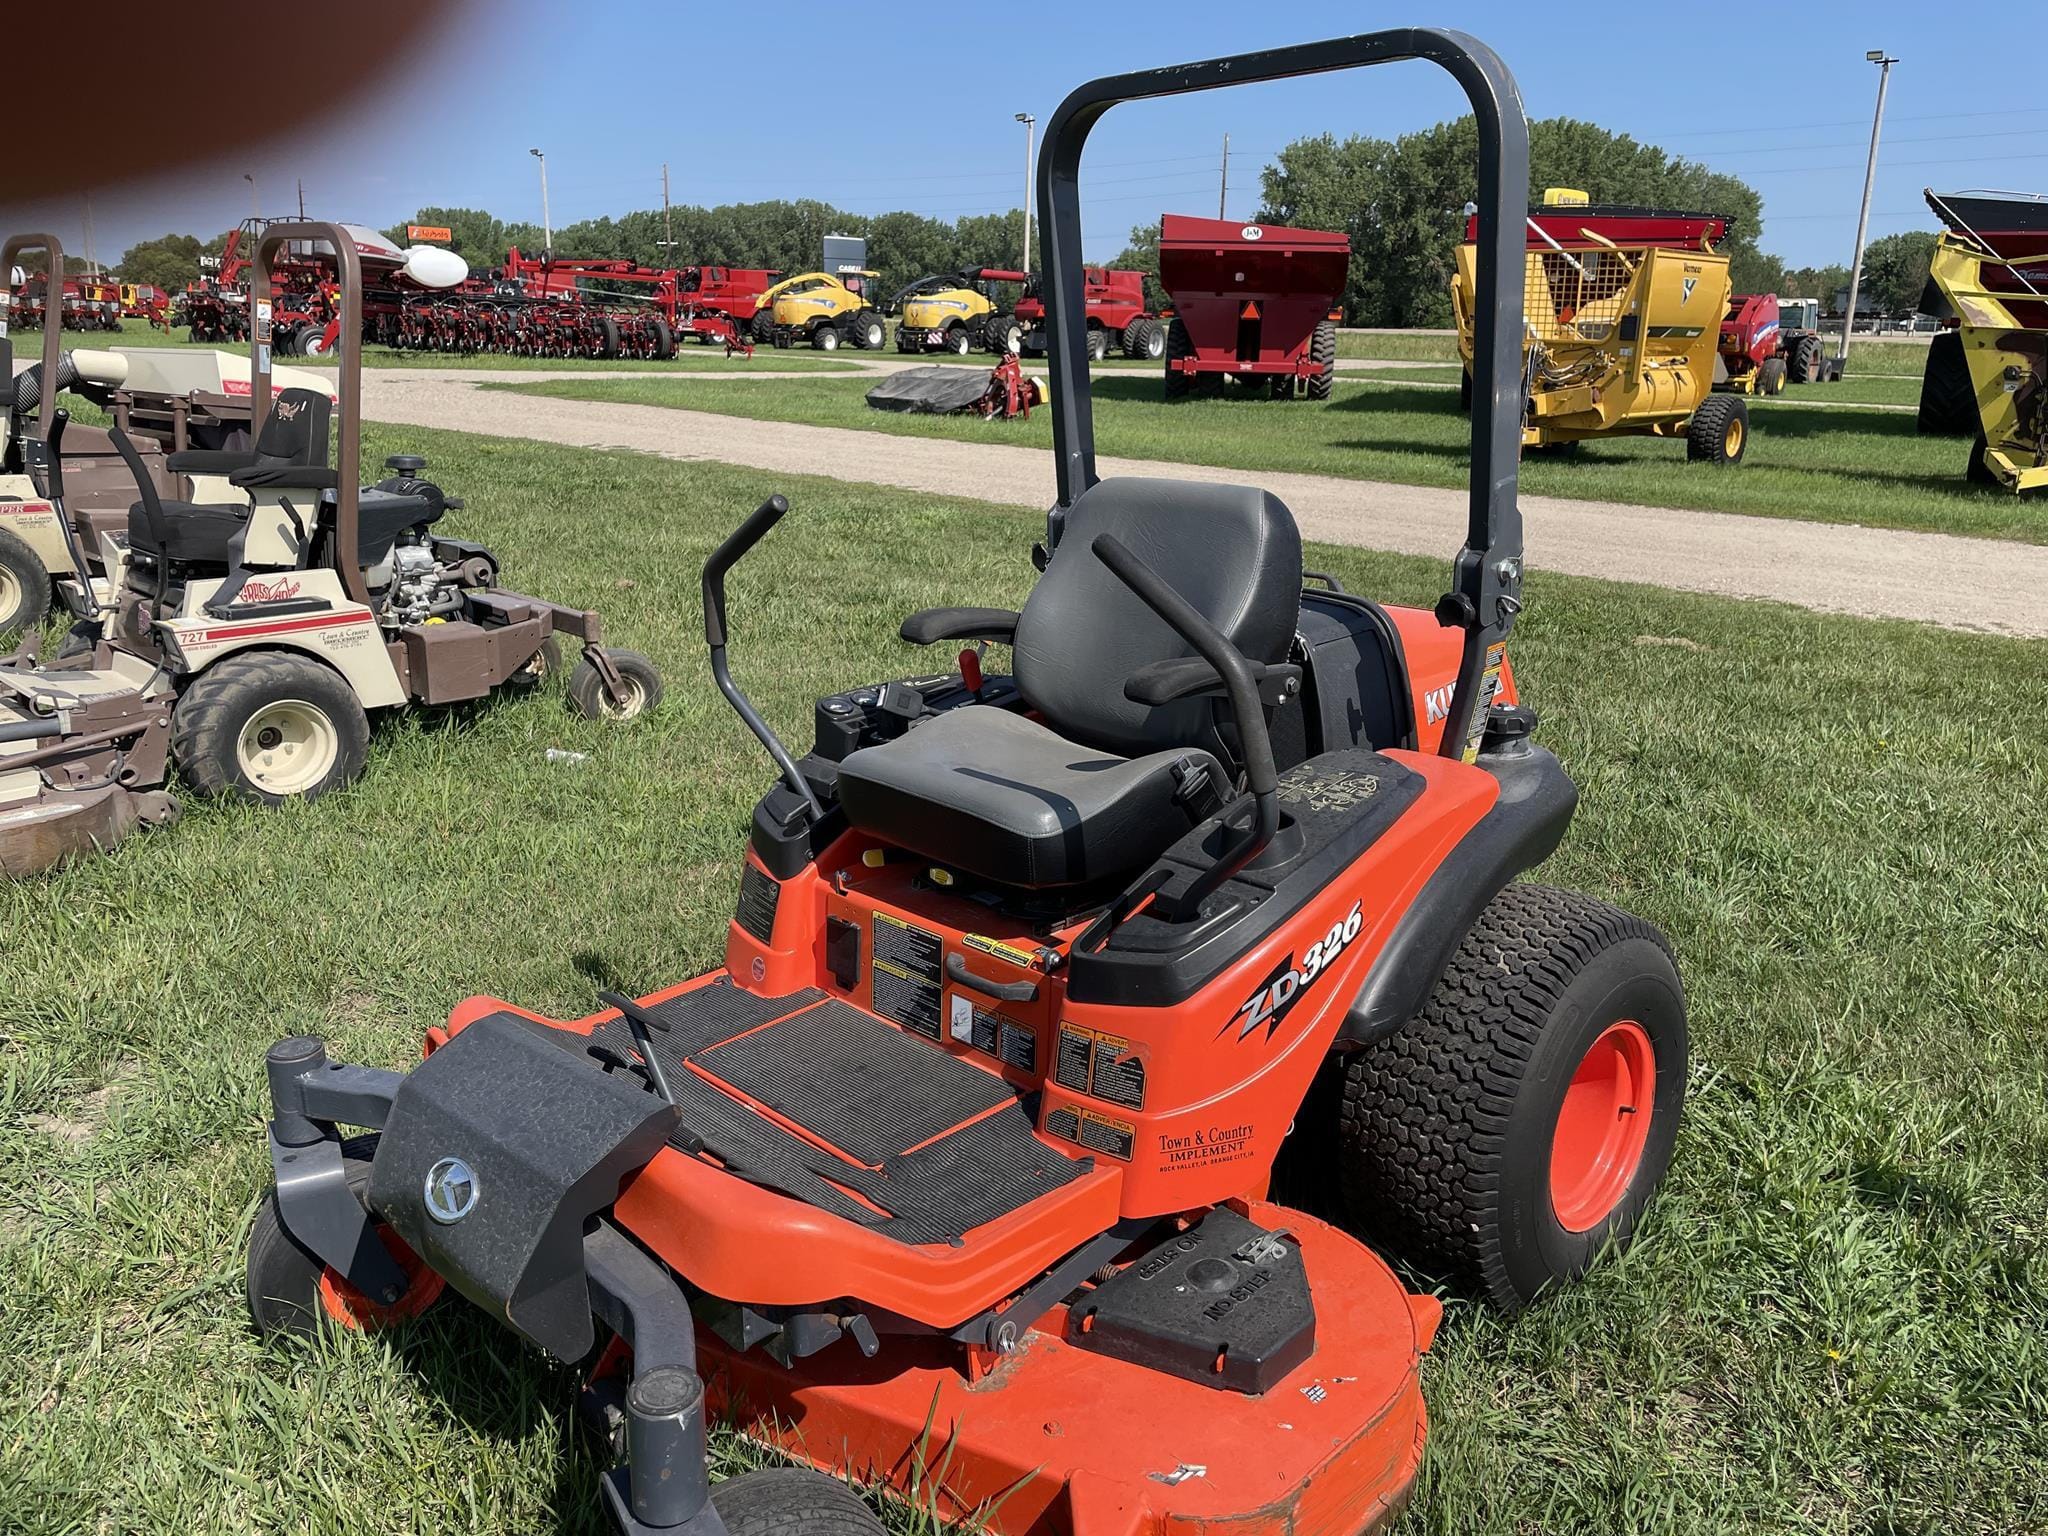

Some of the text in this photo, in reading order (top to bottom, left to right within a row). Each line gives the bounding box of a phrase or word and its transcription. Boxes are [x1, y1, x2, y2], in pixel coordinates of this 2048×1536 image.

[180, 631, 204, 643] 727
[1237, 898, 1364, 1042] ZD326
[1069, 1025, 1090, 1036] WARNING
[1159, 1125, 1254, 1150] Town & Country
[1170, 1140, 1245, 1162] IMPLEMENT
[1210, 1155, 1234, 1165] ORANGE
[1203, 1271, 1272, 1321] NO STEP
